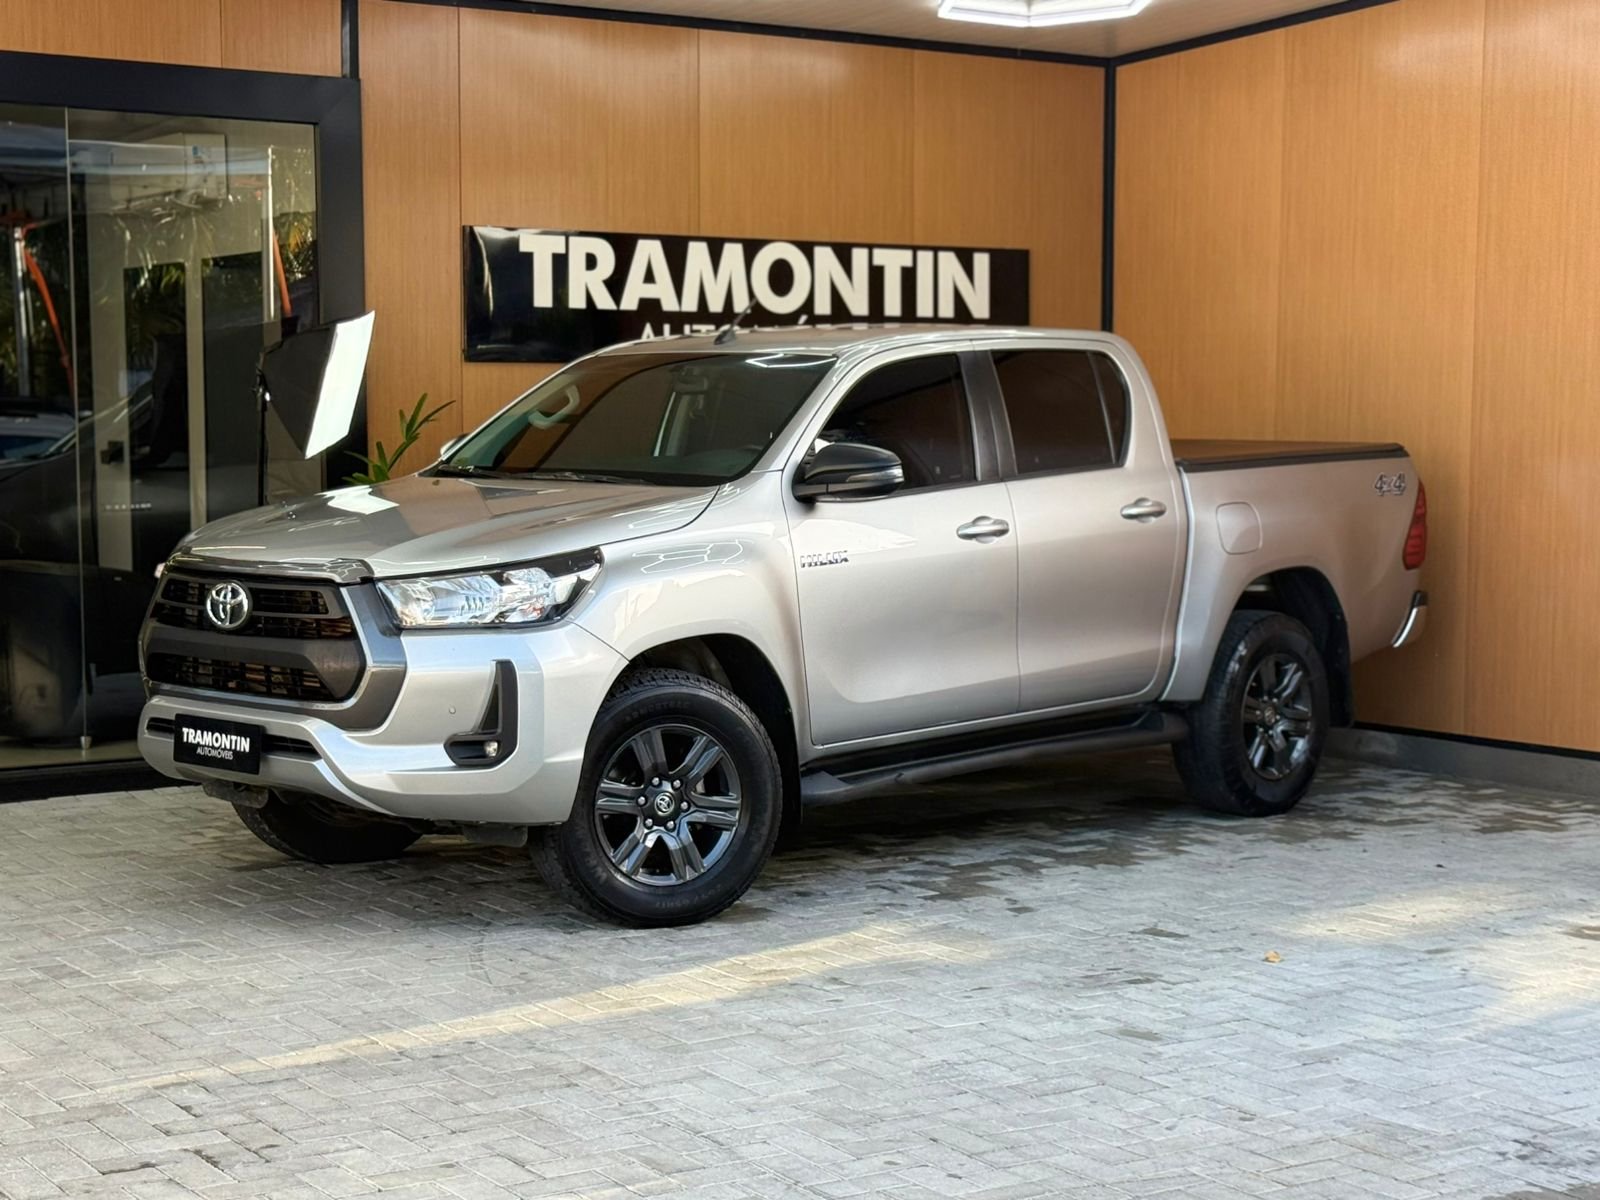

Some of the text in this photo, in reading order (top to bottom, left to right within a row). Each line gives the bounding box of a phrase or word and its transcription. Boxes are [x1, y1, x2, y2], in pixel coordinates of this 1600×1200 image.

[518, 233, 991, 319] TRAMONTIN
[799, 550, 849, 568] HILUX
[181, 727, 251, 753] TRAMONTIN
[196, 746, 234, 760] AUTOMÓVEIS
